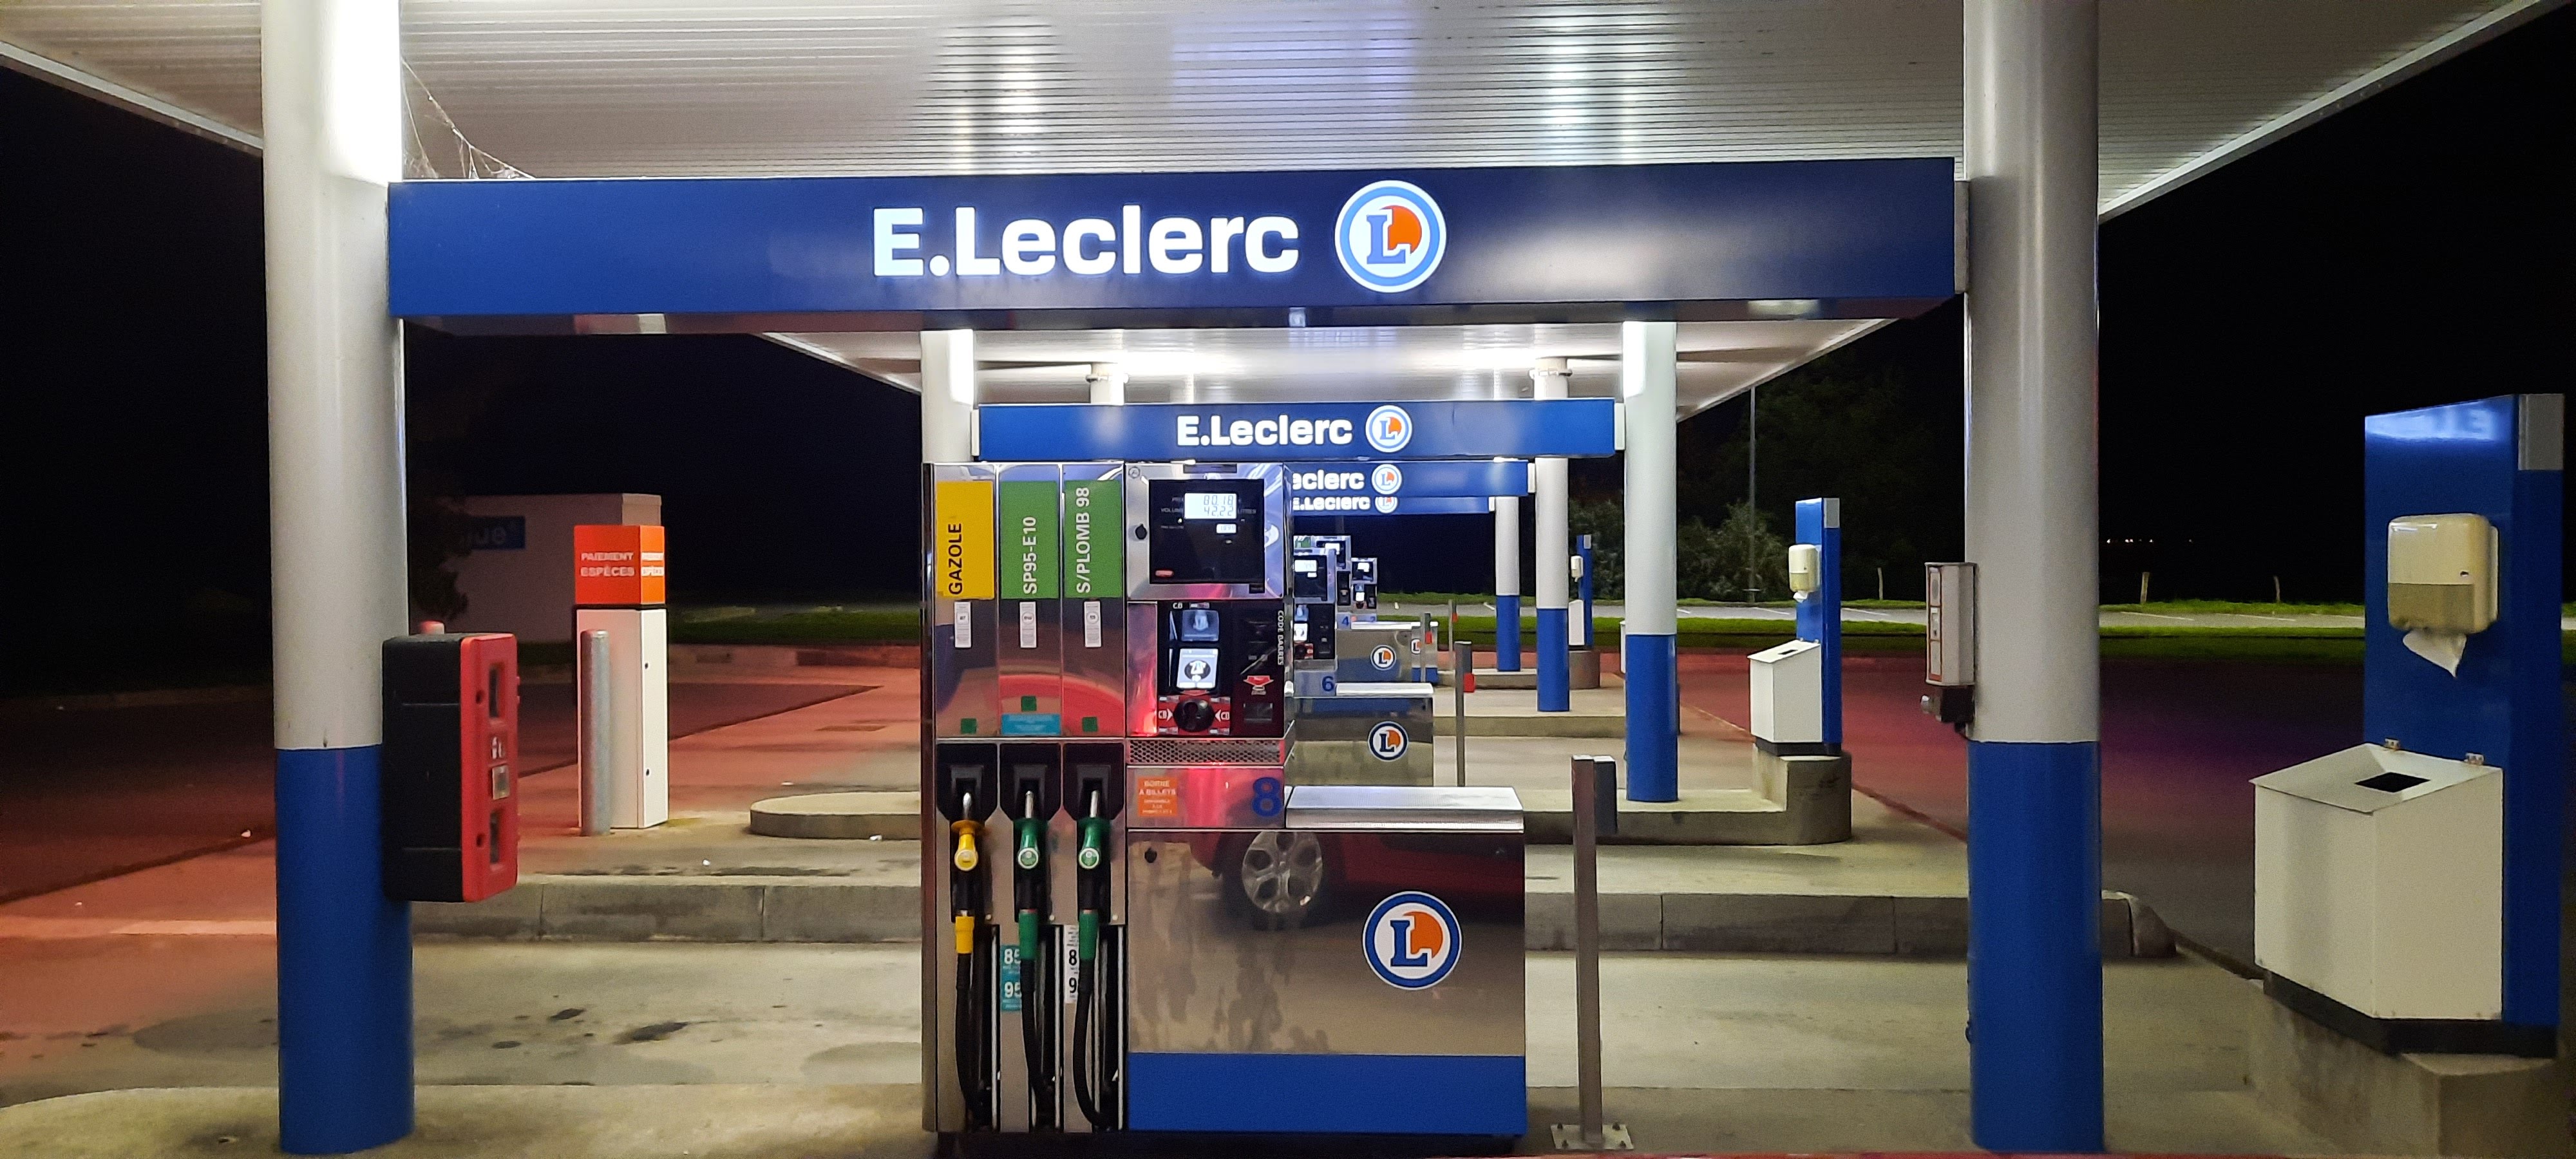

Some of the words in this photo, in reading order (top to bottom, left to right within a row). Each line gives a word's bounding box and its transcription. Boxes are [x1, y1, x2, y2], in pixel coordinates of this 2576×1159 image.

[873, 204, 1300, 278] E.Leclerc
[1177, 415, 1352, 446] E.Leclerc
[1075, 487, 1090, 507] 98
[947, 523, 963, 595] GAZOLE
[1022, 516, 1037, 594] SP95-E10
[1075, 512, 1091, 593] S/PLOMB
[1321, 675, 1334, 692] 6
[1251, 777, 1282, 817] 8
[1068, 949, 1077, 966] 8
[1068, 977, 1077, 994] 9
